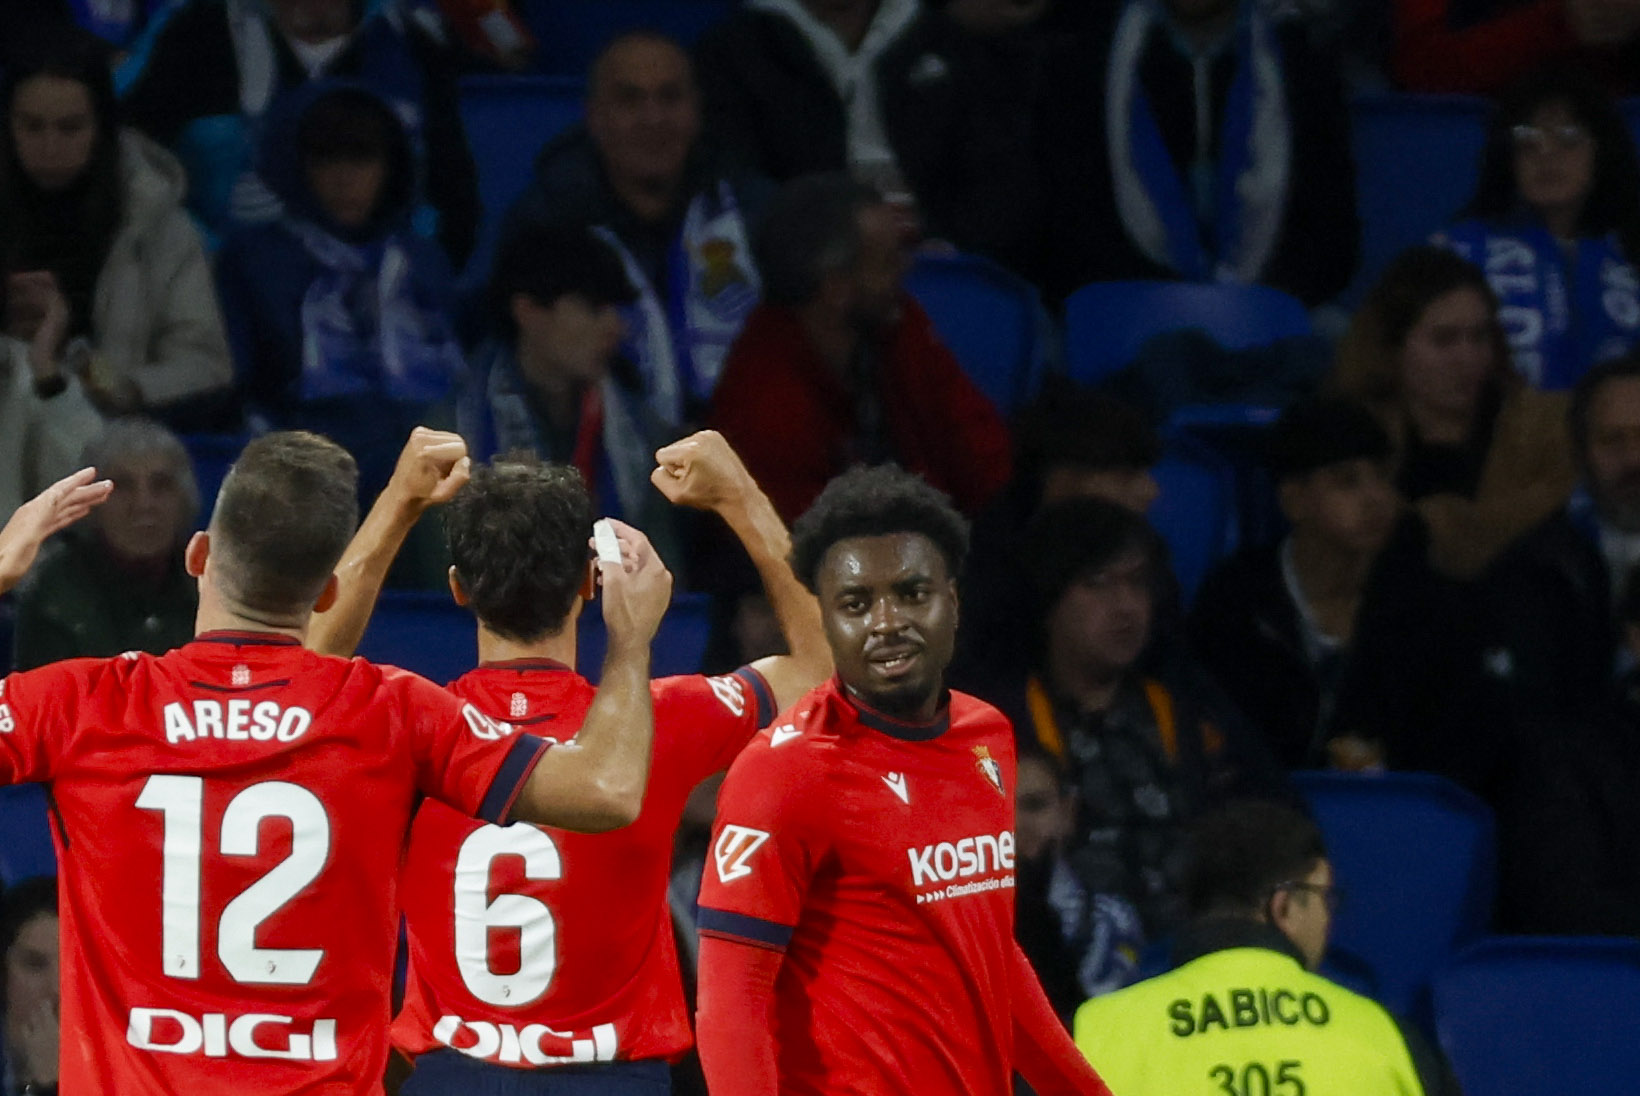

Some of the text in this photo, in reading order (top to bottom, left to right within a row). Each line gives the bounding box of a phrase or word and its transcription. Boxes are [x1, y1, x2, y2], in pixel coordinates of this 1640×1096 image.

[163, 699, 312, 744] ARESO
[134, 774, 331, 985] 12
[454, 821, 562, 1007] 6
[125, 1006, 338, 1062] DIGI
[1167, 987, 1330, 1038] SABICO
[432, 1014, 618, 1066] DIGI
